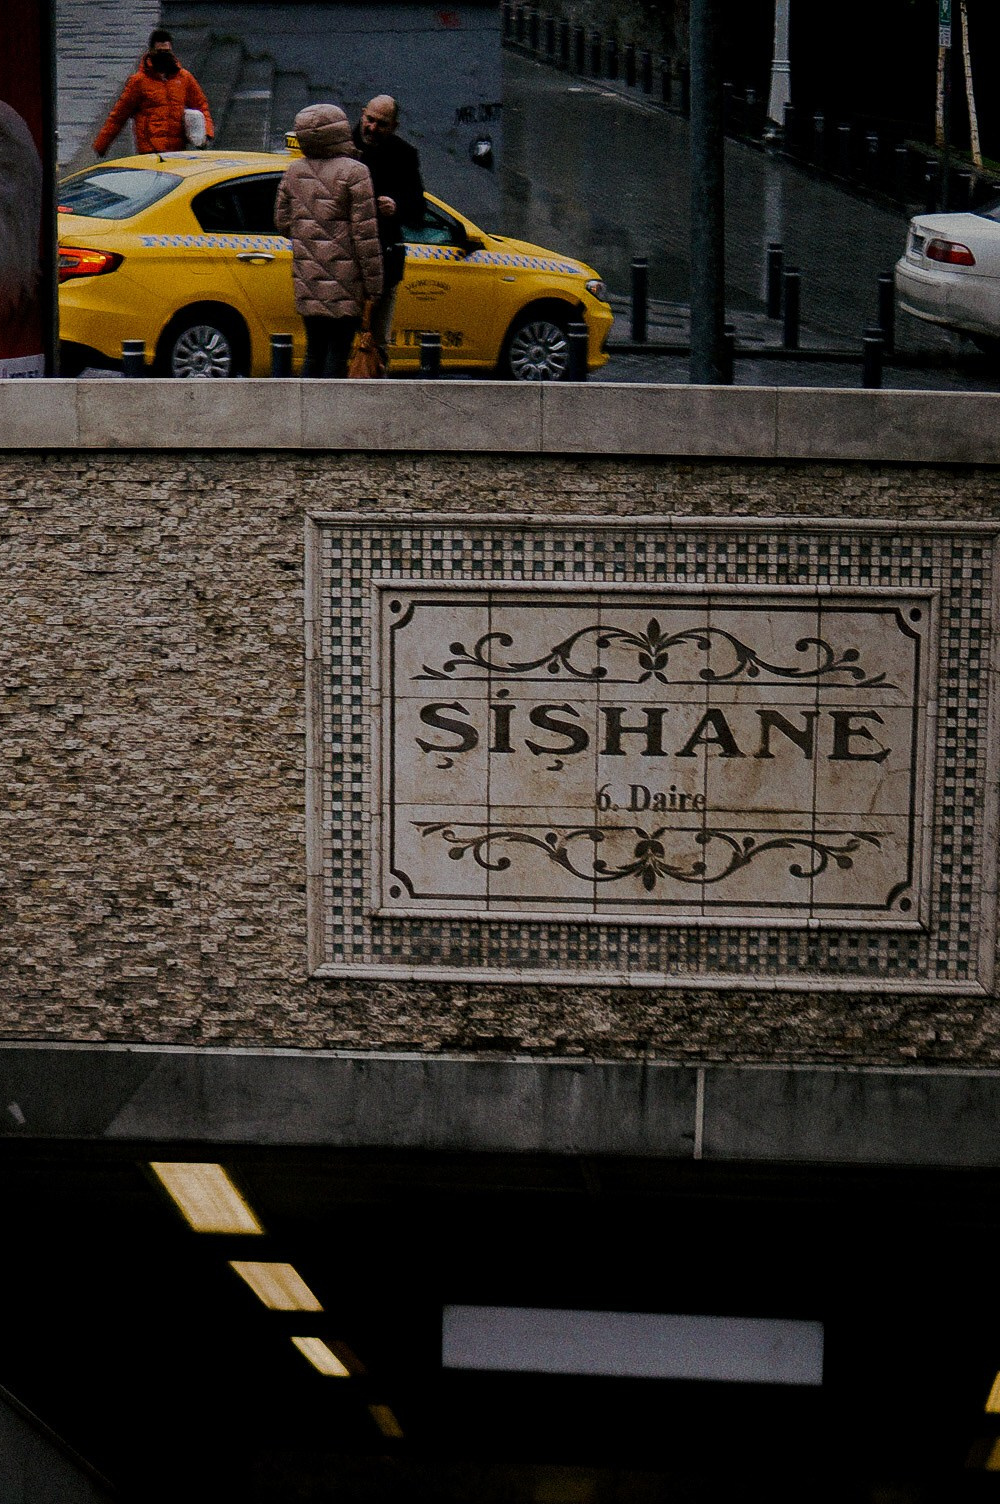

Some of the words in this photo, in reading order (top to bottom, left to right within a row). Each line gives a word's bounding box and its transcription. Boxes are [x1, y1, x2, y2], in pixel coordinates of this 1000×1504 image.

[414, 688, 892, 772] ŞİŞHANE
[596, 782, 619, 813] 6.
[627, 783, 706, 813] Daire
